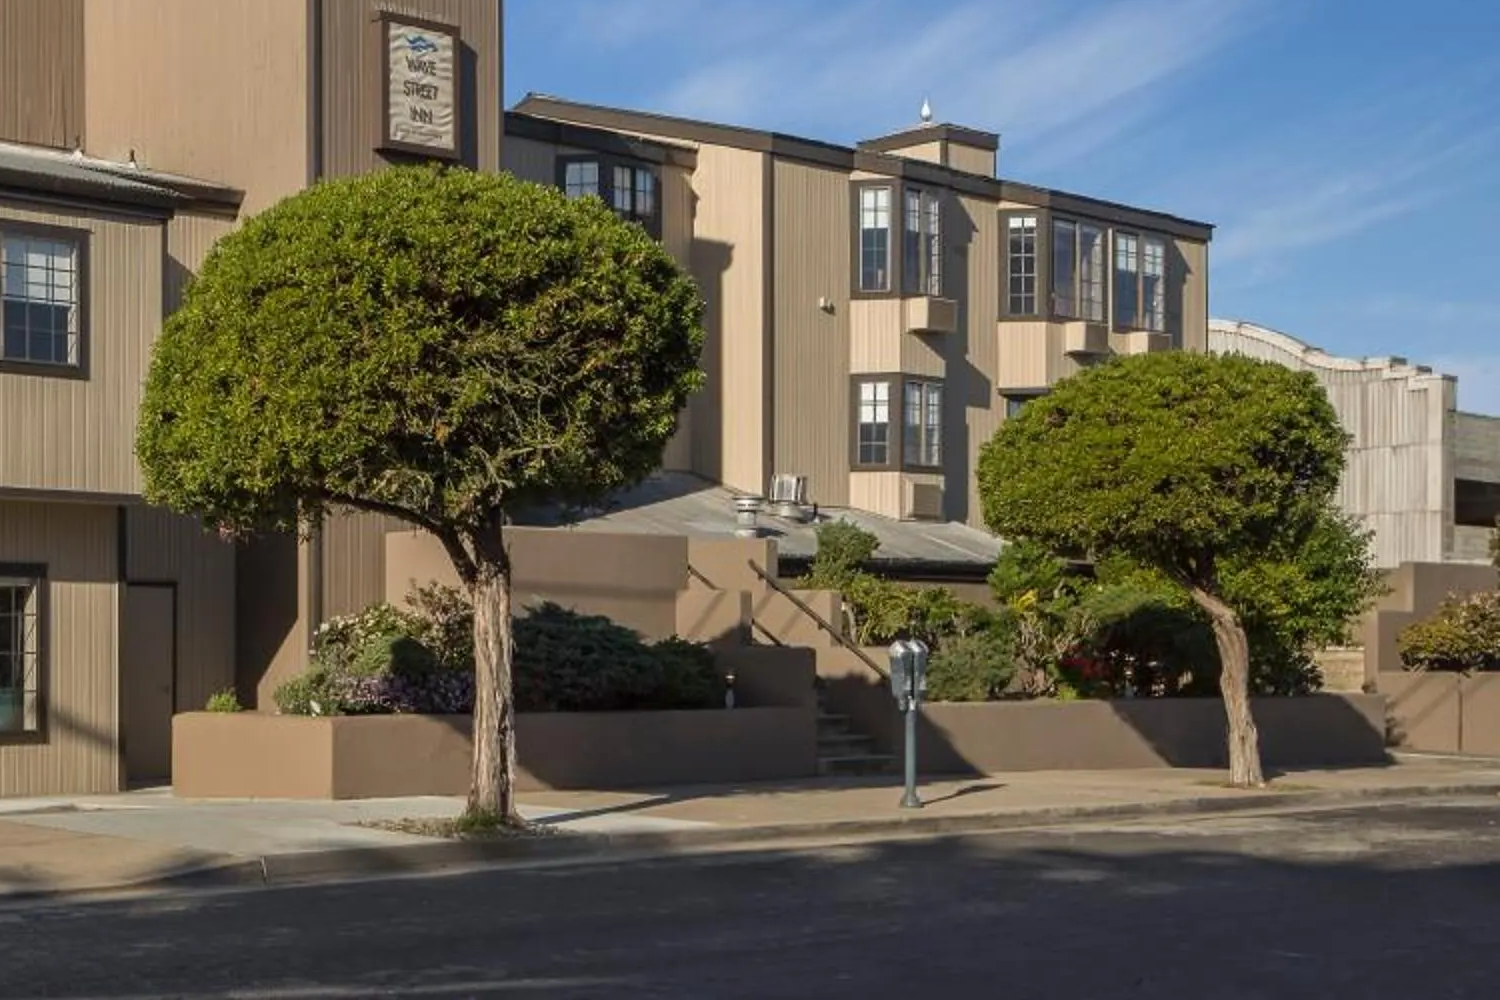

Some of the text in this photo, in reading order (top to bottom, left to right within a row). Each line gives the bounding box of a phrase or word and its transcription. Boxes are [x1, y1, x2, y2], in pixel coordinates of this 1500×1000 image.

[405, 55, 437, 76] WAVE
[403, 81, 438, 100] STREET
[409, 104, 433, 125] INN
